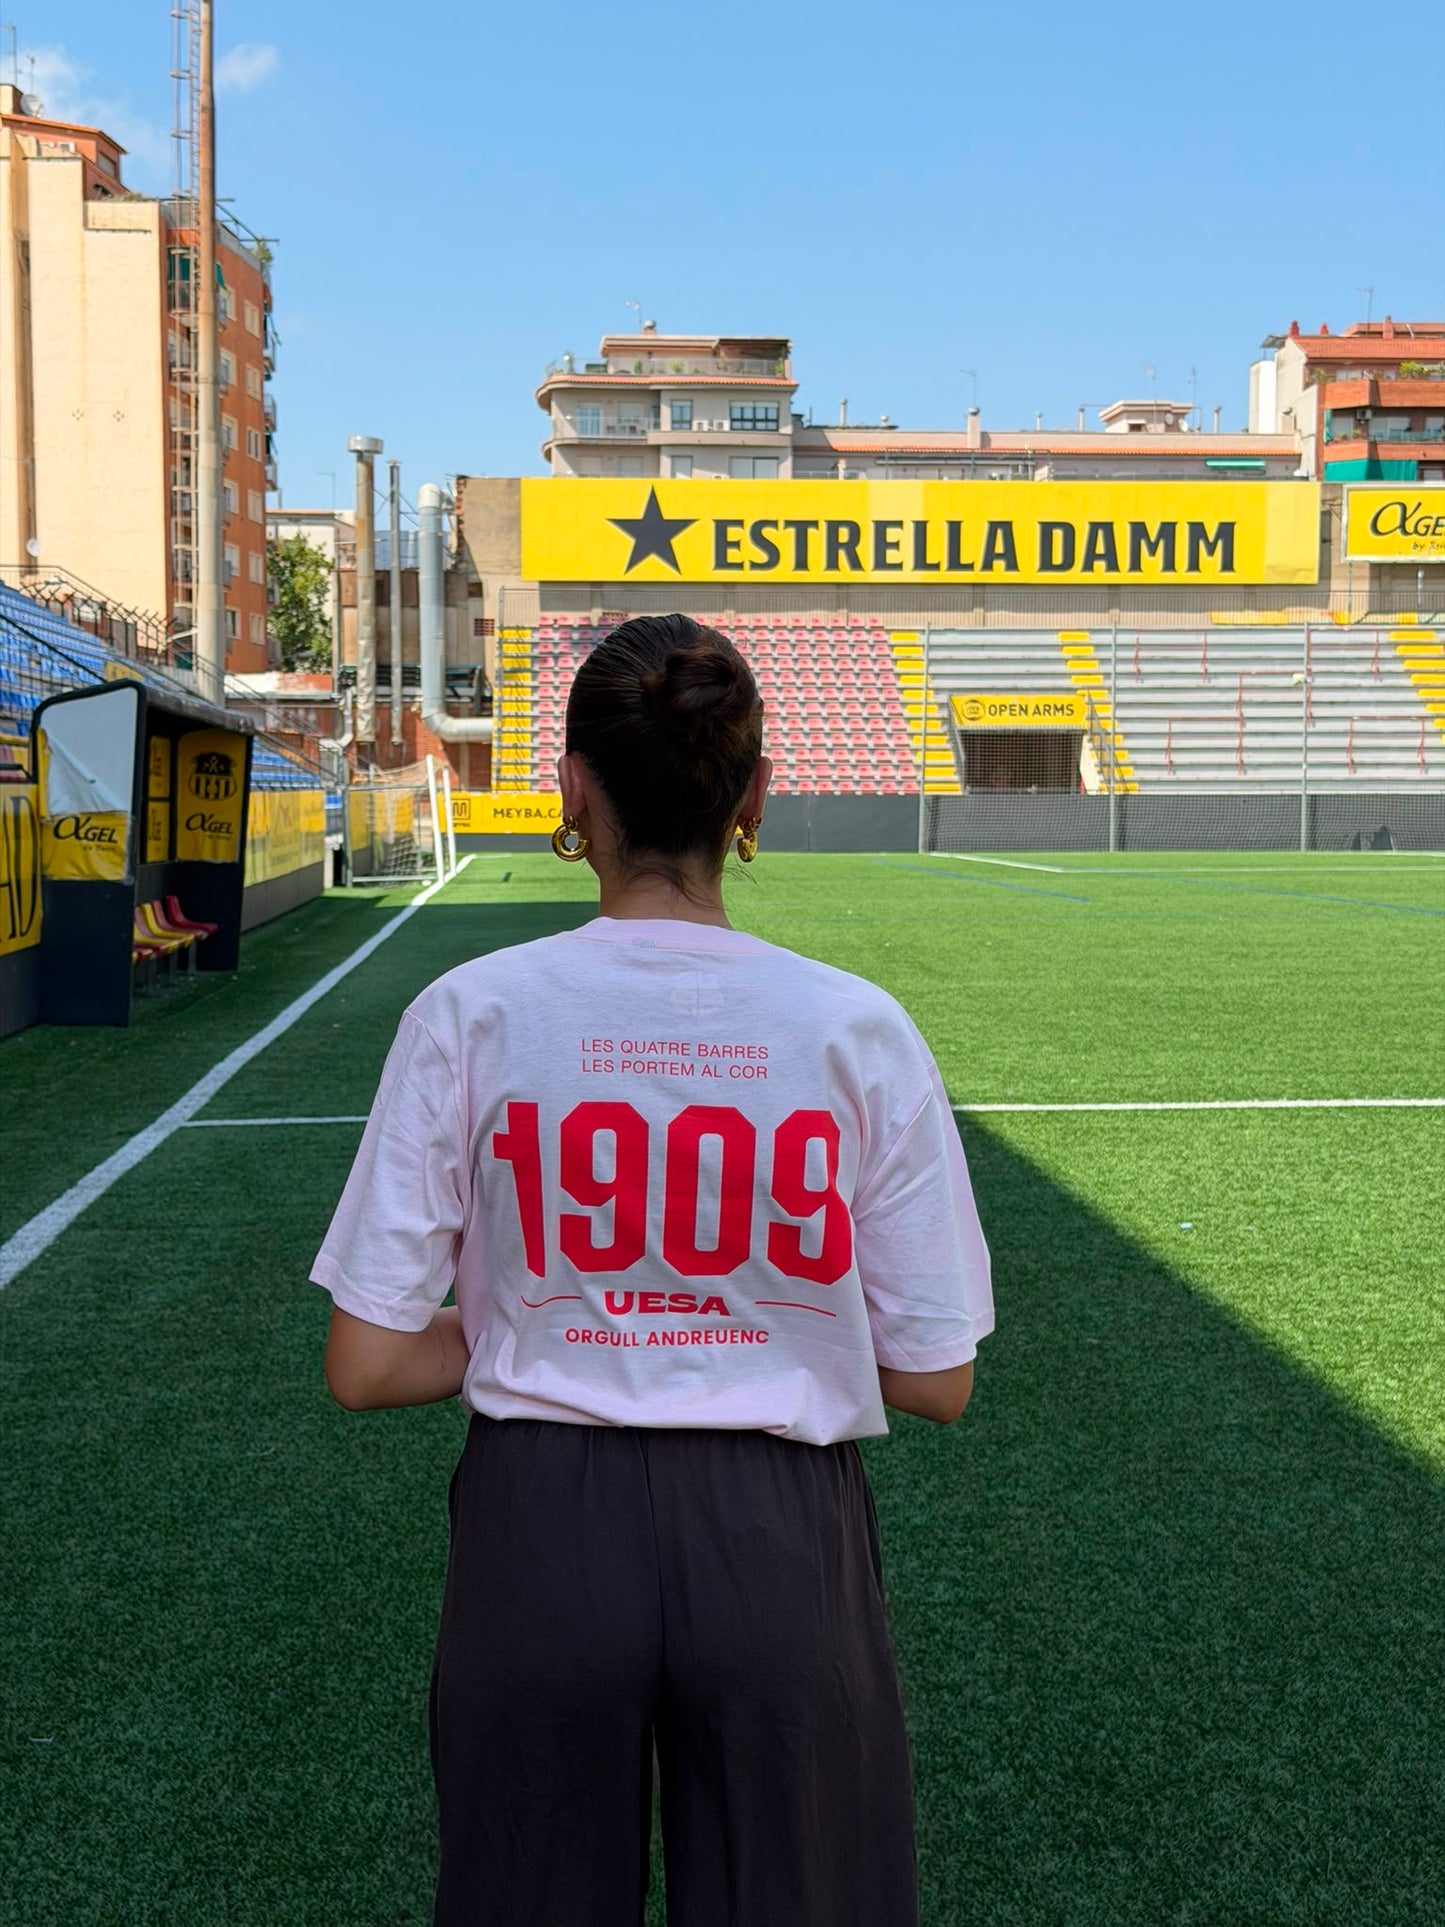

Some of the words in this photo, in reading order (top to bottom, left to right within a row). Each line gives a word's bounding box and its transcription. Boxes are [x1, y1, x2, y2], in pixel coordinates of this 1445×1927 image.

[712, 519, 1020, 573] ESTRELLA
[1036, 520, 1237, 573] DAMM
[988, 703, 1028, 716] OPEN
[1032, 703, 1074, 716] ARMS
[581, 1039, 614, 1053] LES
[620, 1040, 691, 1056] QUATRE
[697, 1044, 769, 1060] BARRES
[581, 1059, 615, 1073] LES
[621, 1060, 695, 1076] PORTEM
[701, 1065, 723, 1078] AL
[729, 1065, 768, 1079] COR
[492, 1101, 854, 1286] 1909
[604, 1290, 731, 1317] UESA
[564, 1328, 640, 1348] ORGULL
[646, 1328, 770, 1347] ANDREUENC
